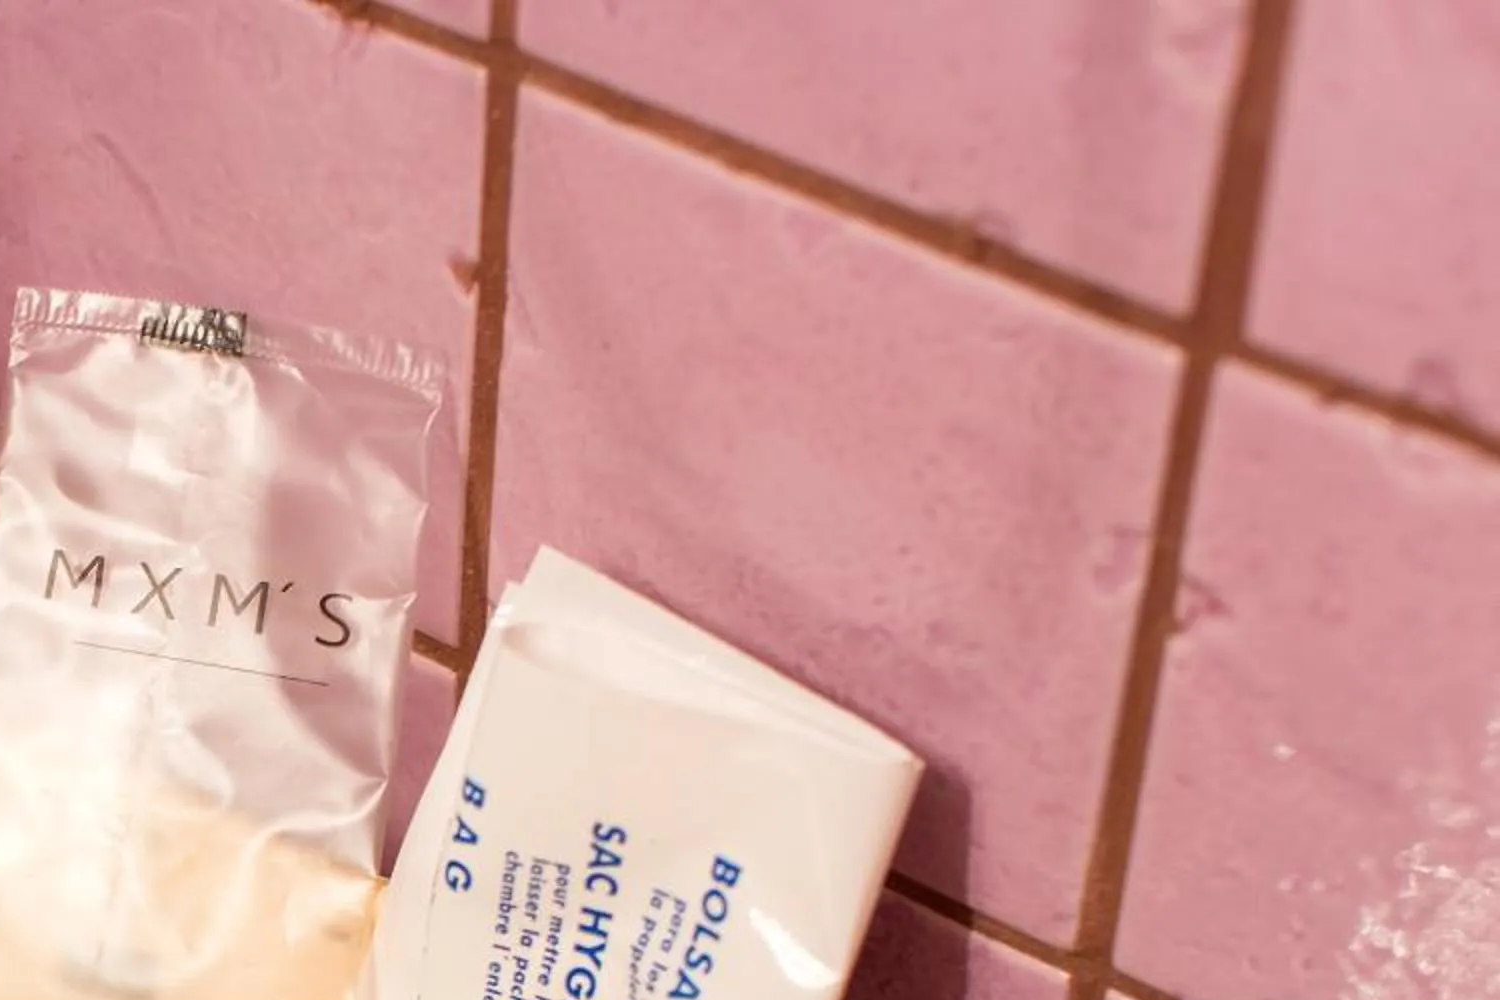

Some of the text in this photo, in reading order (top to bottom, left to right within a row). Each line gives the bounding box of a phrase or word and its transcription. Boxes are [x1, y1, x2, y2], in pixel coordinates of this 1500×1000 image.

[552, 863, 571, 909] pour
[584, 822, 628, 897] SAC
[495, 850, 524, 935] chambre
[524, 856, 549, 922] laisser
[649, 887, 671, 910] la
[520, 927, 540, 949] la
[538, 915, 563, 986] mettre
[660, 896, 688, 954] para
[646, 960, 669, 993] los
